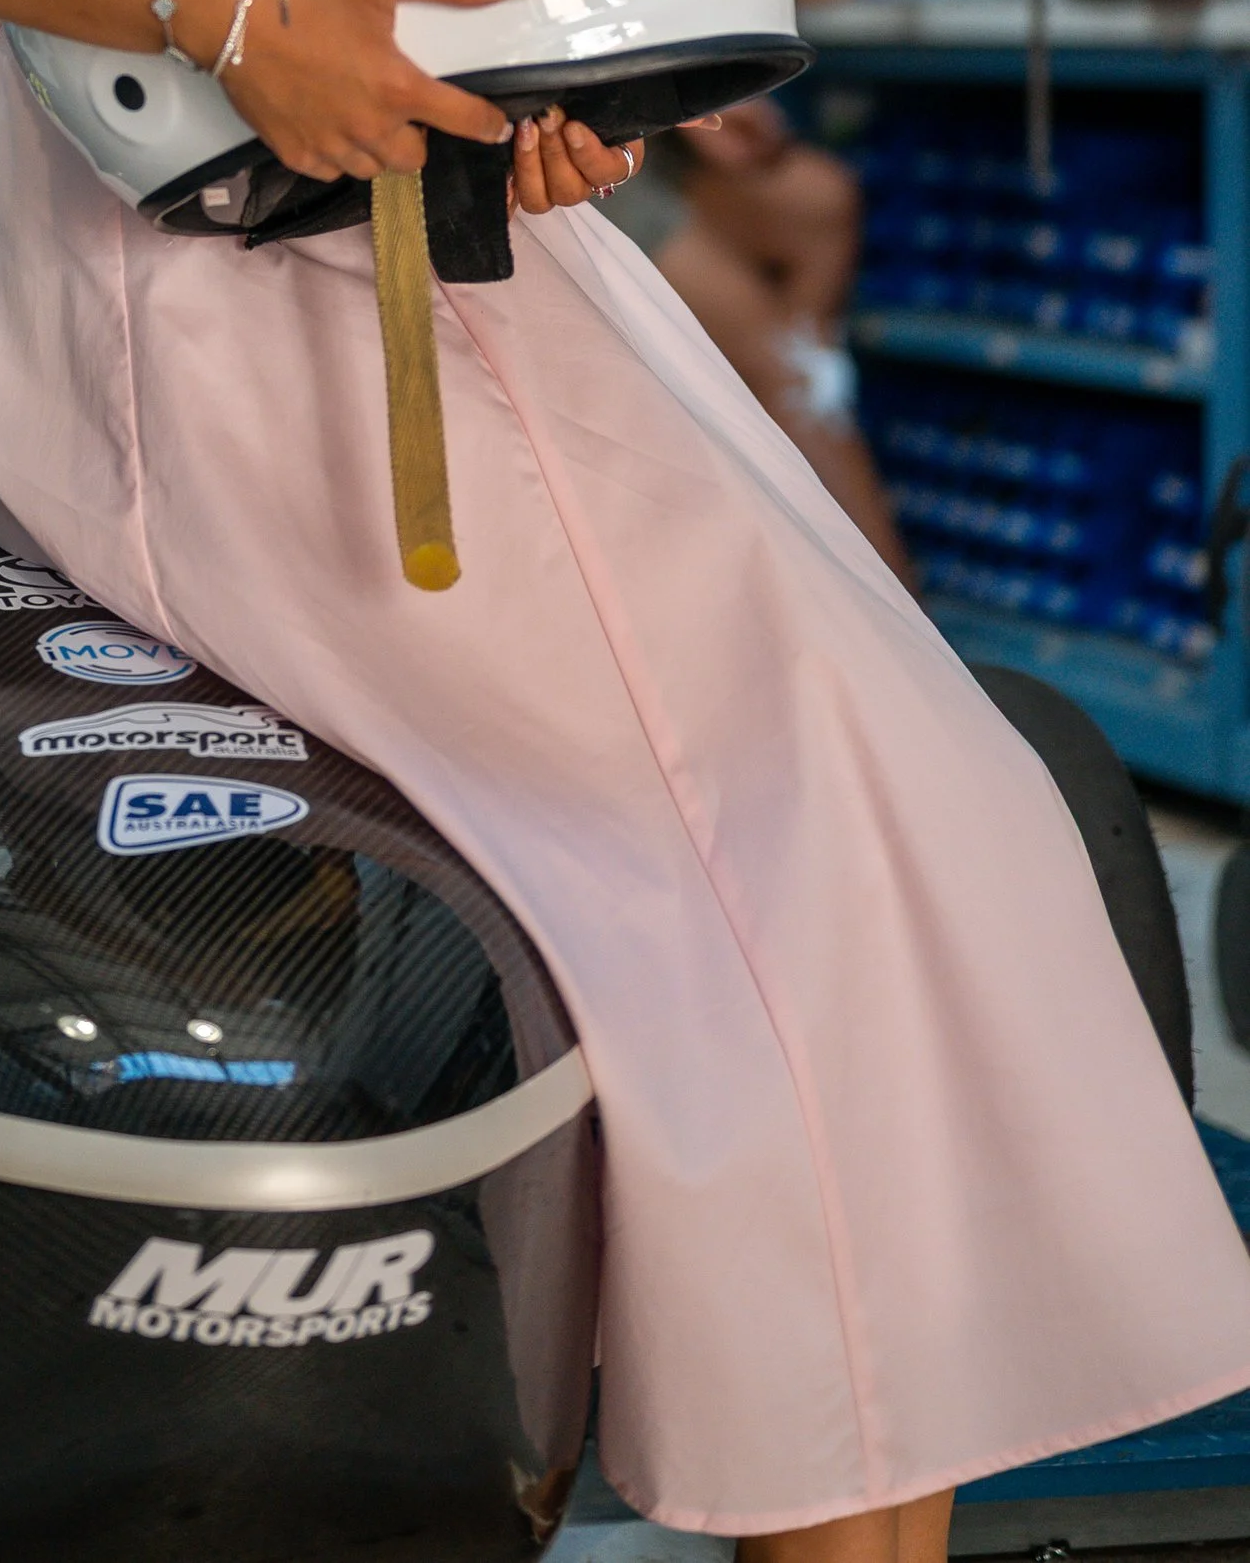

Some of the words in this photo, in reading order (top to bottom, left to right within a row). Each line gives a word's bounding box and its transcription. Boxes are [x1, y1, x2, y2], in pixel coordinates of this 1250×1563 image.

[33, 729, 296, 751] motorsport
[213, 745, 300, 757] australia
[125, 792, 261, 818] SAE
[123, 818, 260, 832] AUSTRALASIA
[104, 1228, 436, 1316] MUR
[88, 1292, 436, 1349] MOTORSPORTS
